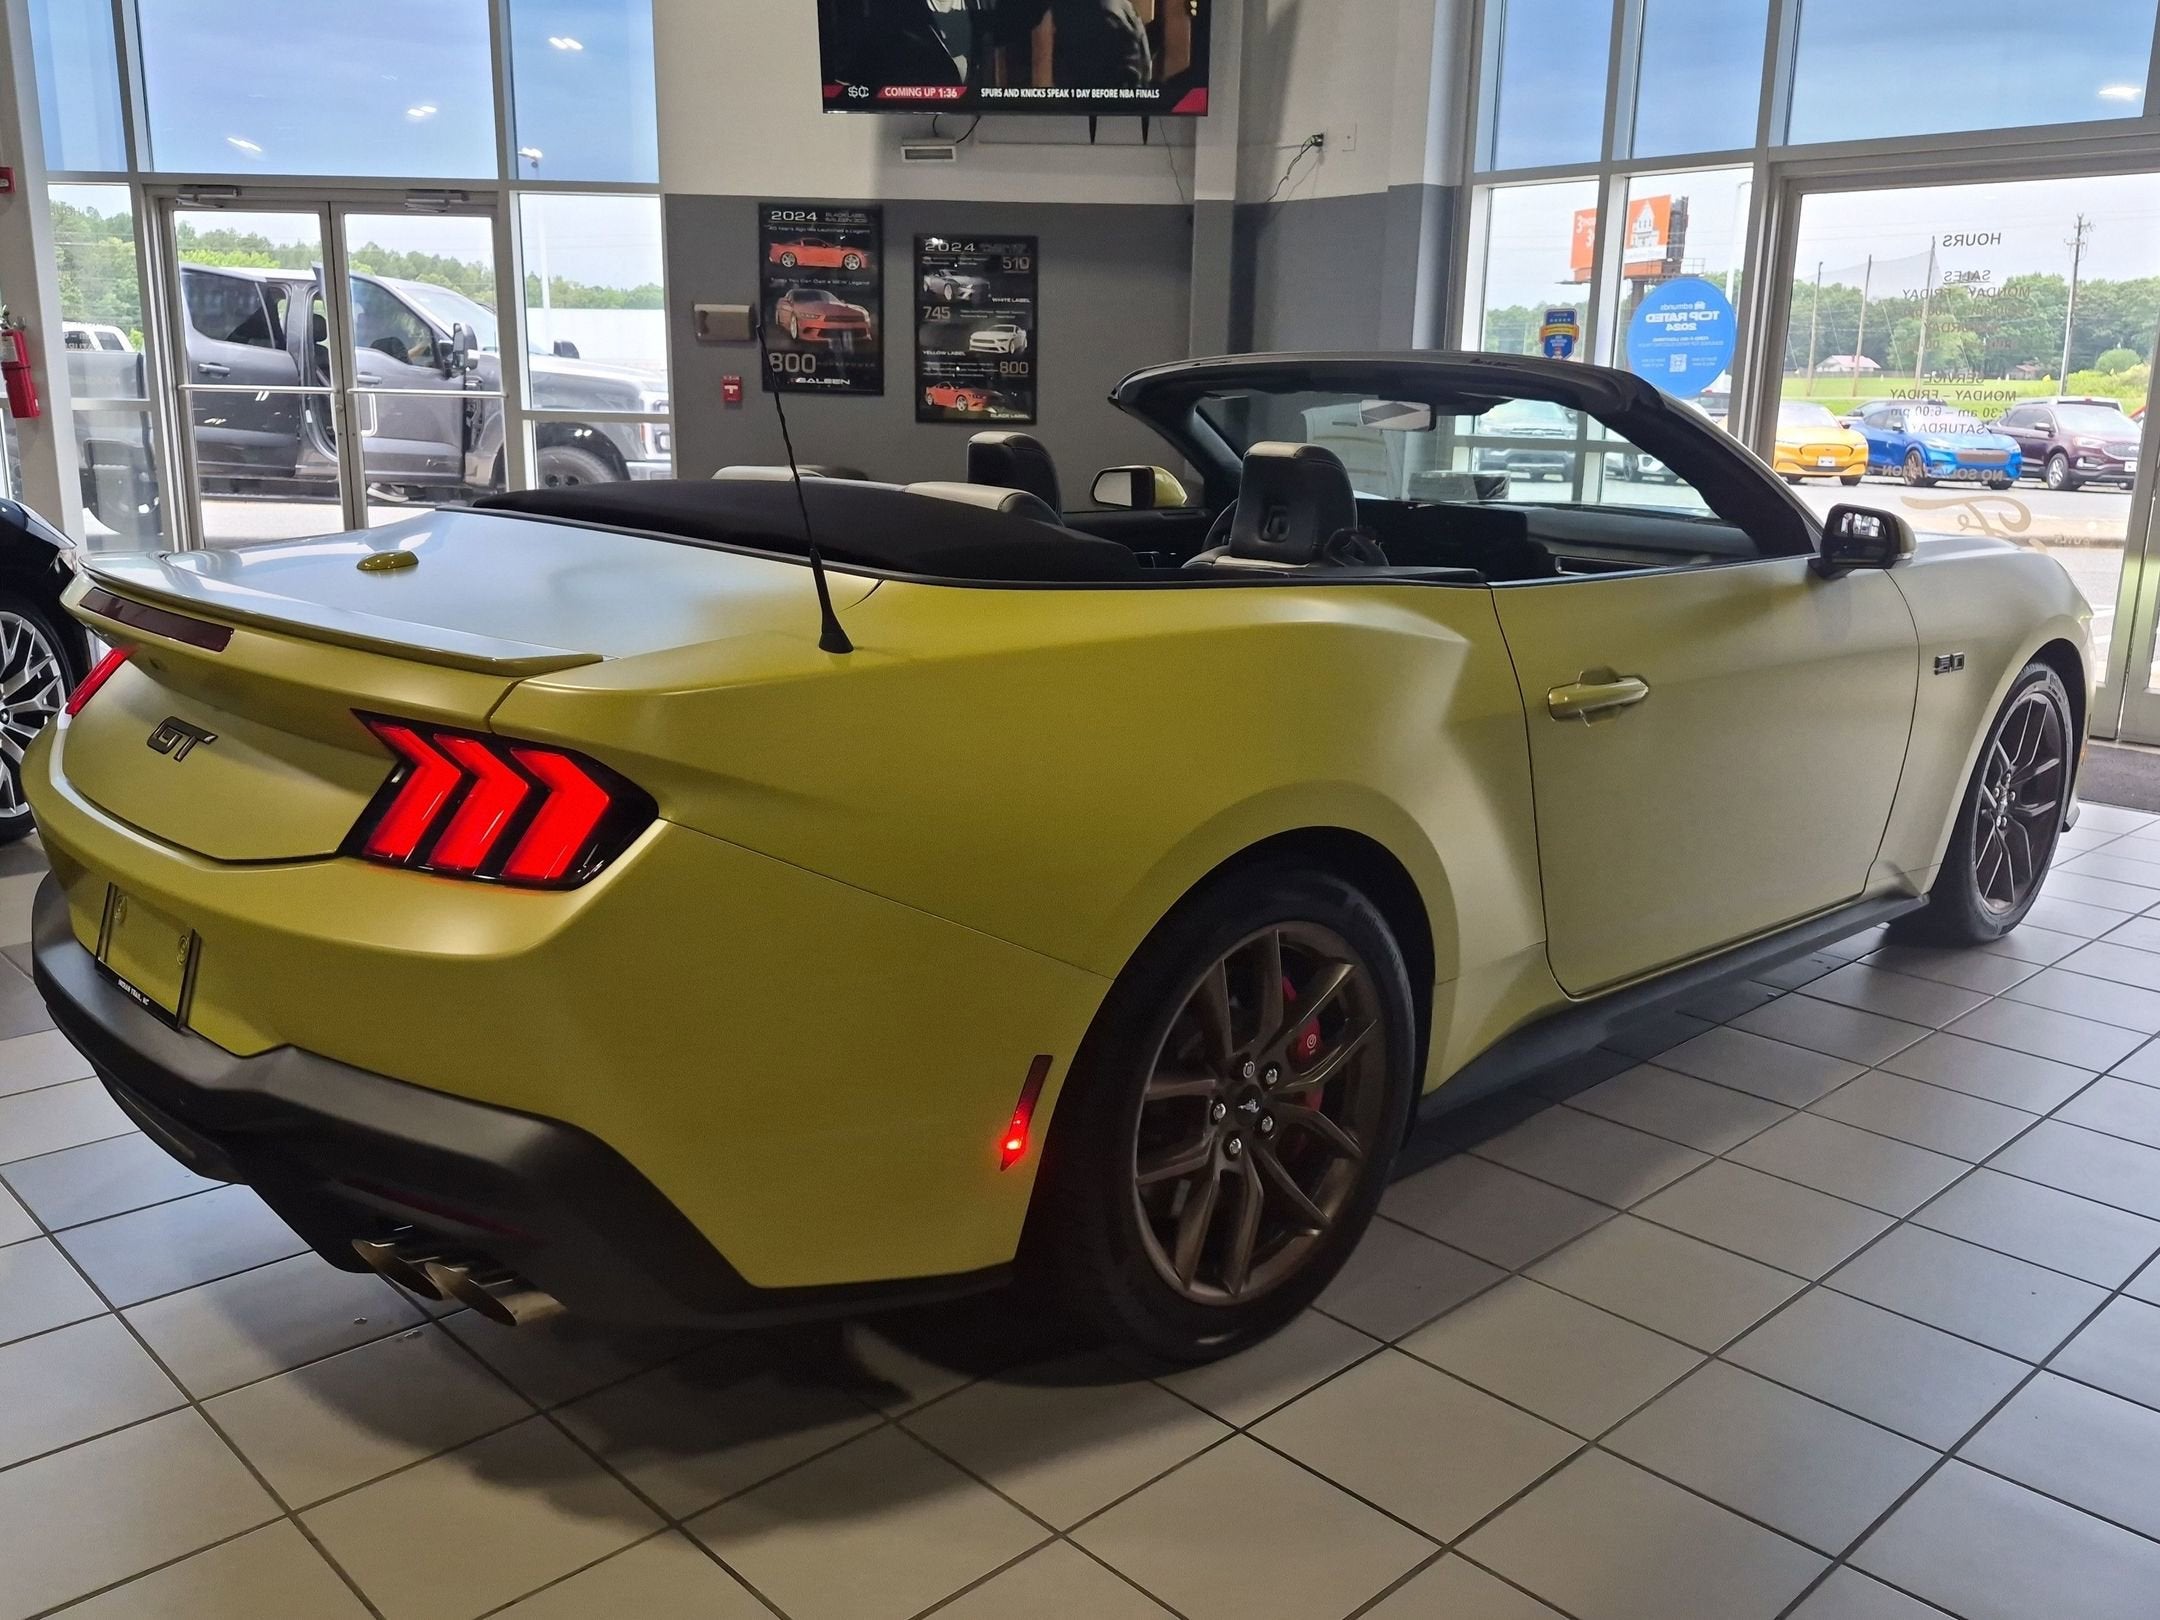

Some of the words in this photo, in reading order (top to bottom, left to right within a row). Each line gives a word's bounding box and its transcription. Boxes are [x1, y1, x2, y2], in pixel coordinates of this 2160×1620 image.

[885, 87, 922, 98] COMING
[923, 88, 936, 98] UP
[938, 88, 958, 99] 1:36
[981, 88, 1003, 98] SPURS
[1004, 88, 1020, 98] AND
[1020, 88, 1046, 98] KNICKS
[1047, 88, 1069, 98] SPEAK
[1070, 89, 1075, 98] 1
[1076, 89, 1090, 98] DAY
[1091, 89, 1118, 98] BEFORE
[1119, 89, 1134, 98] NBA
[1135, 89, 1160, 98] FINALS
[770, 210, 817, 222] 2024
[925, 242, 976, 253] 2024
[1002, 256, 1031, 270] 510
[923, 305, 952, 319] 745
[768, 352, 817, 374] 800
[1000, 361, 1029, 374] 800
[796, 377, 851, 385] SALEEN
[147, 715, 219, 763] GT
